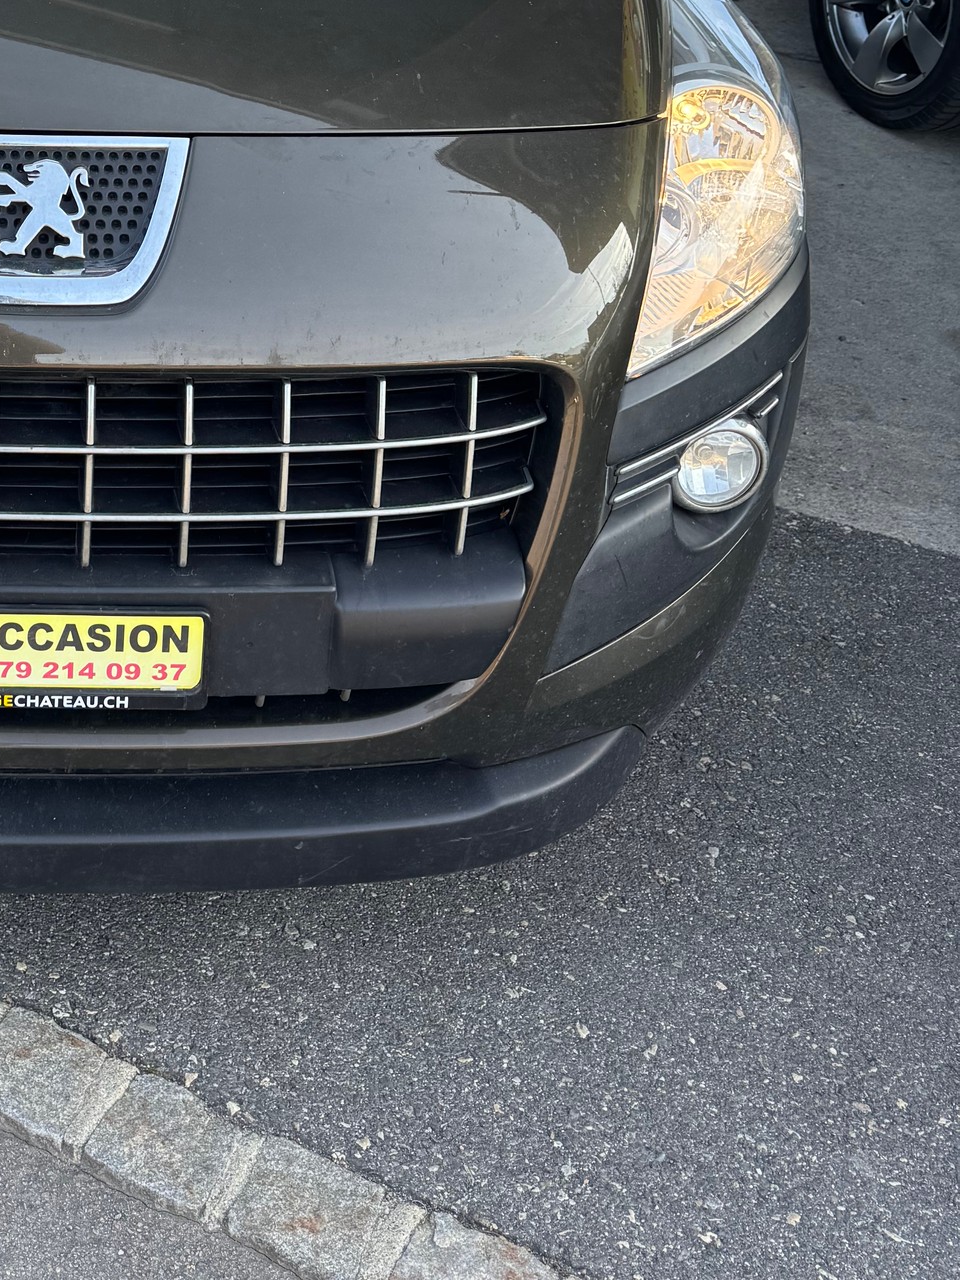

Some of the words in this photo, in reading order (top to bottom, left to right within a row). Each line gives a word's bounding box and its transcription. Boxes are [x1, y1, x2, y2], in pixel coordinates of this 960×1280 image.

[42, 661, 96, 680] 214
[105, 662, 141, 680] 09
[151, 663, 187, 681] 37
